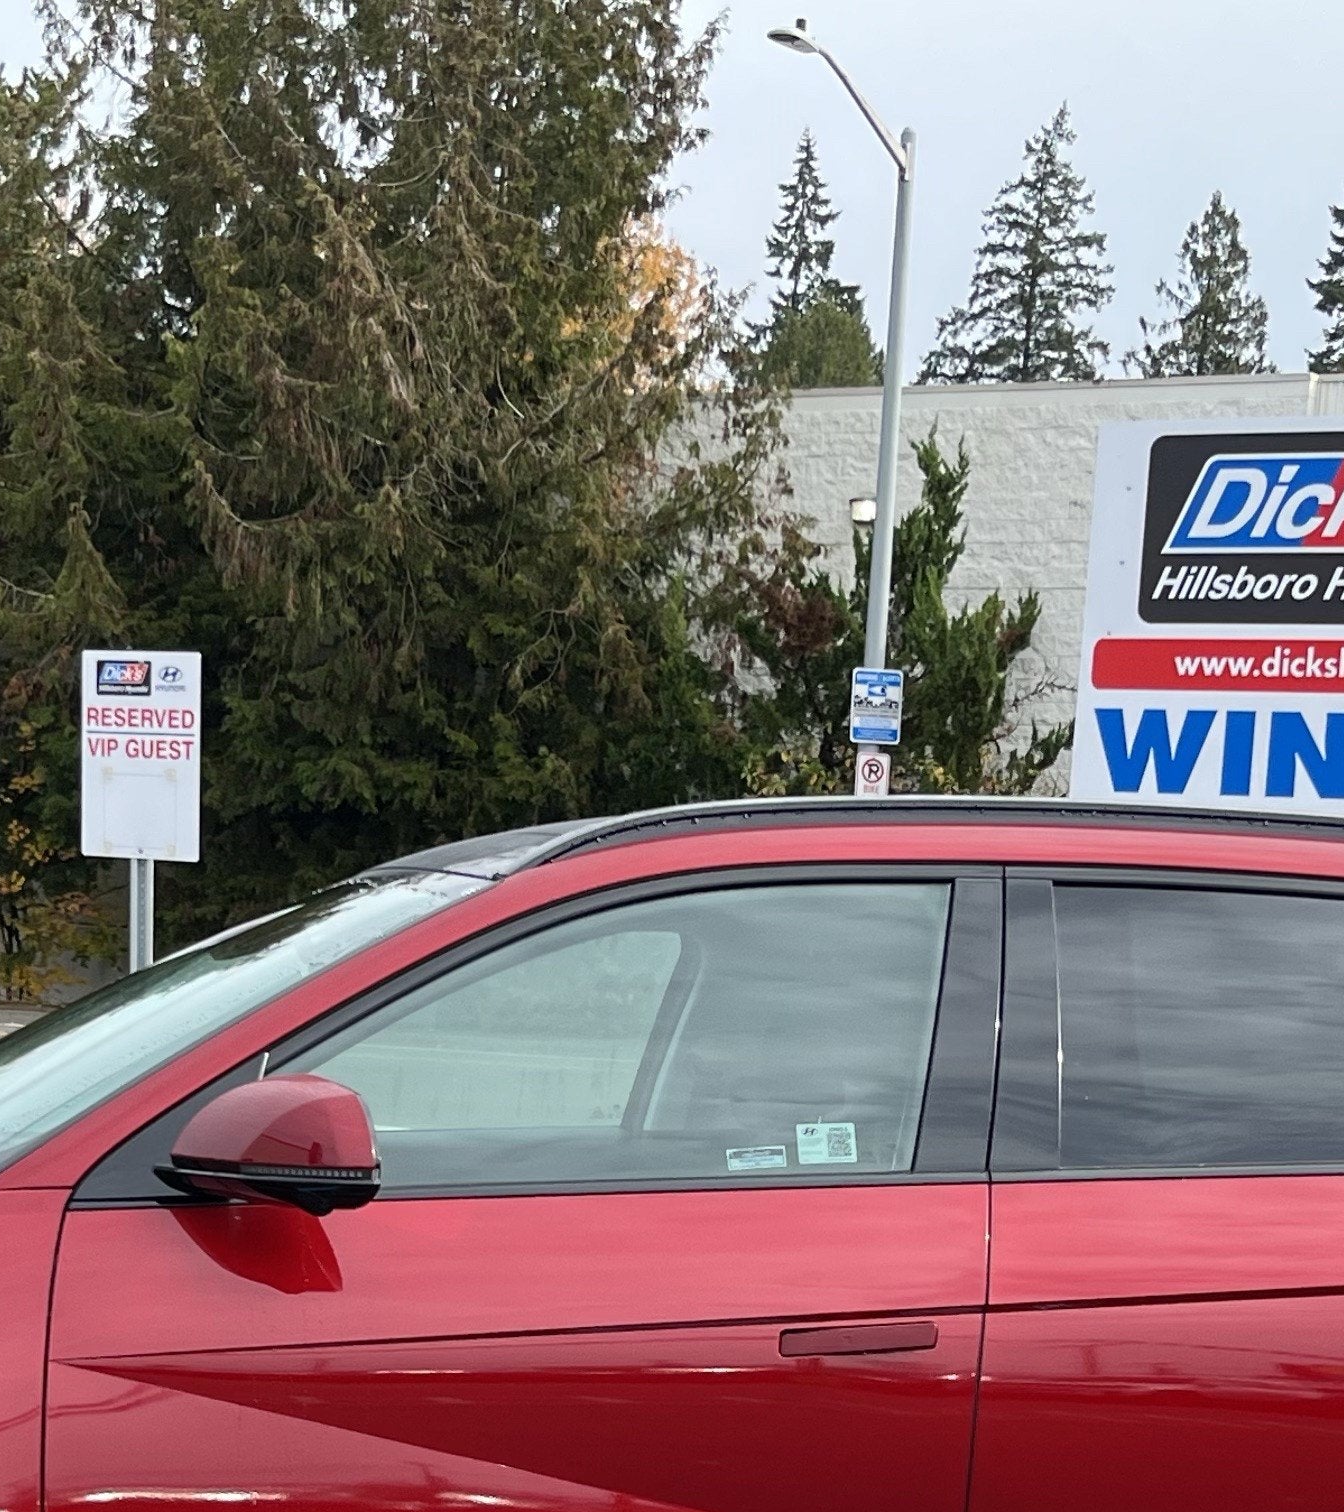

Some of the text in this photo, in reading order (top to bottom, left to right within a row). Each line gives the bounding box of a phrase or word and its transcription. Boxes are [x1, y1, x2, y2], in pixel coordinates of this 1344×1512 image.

[1151, 565, 1318, 601] Hillsboro
[86, 707, 195, 729] RESERVED
[87, 737, 195, 760] VIP GUEST
